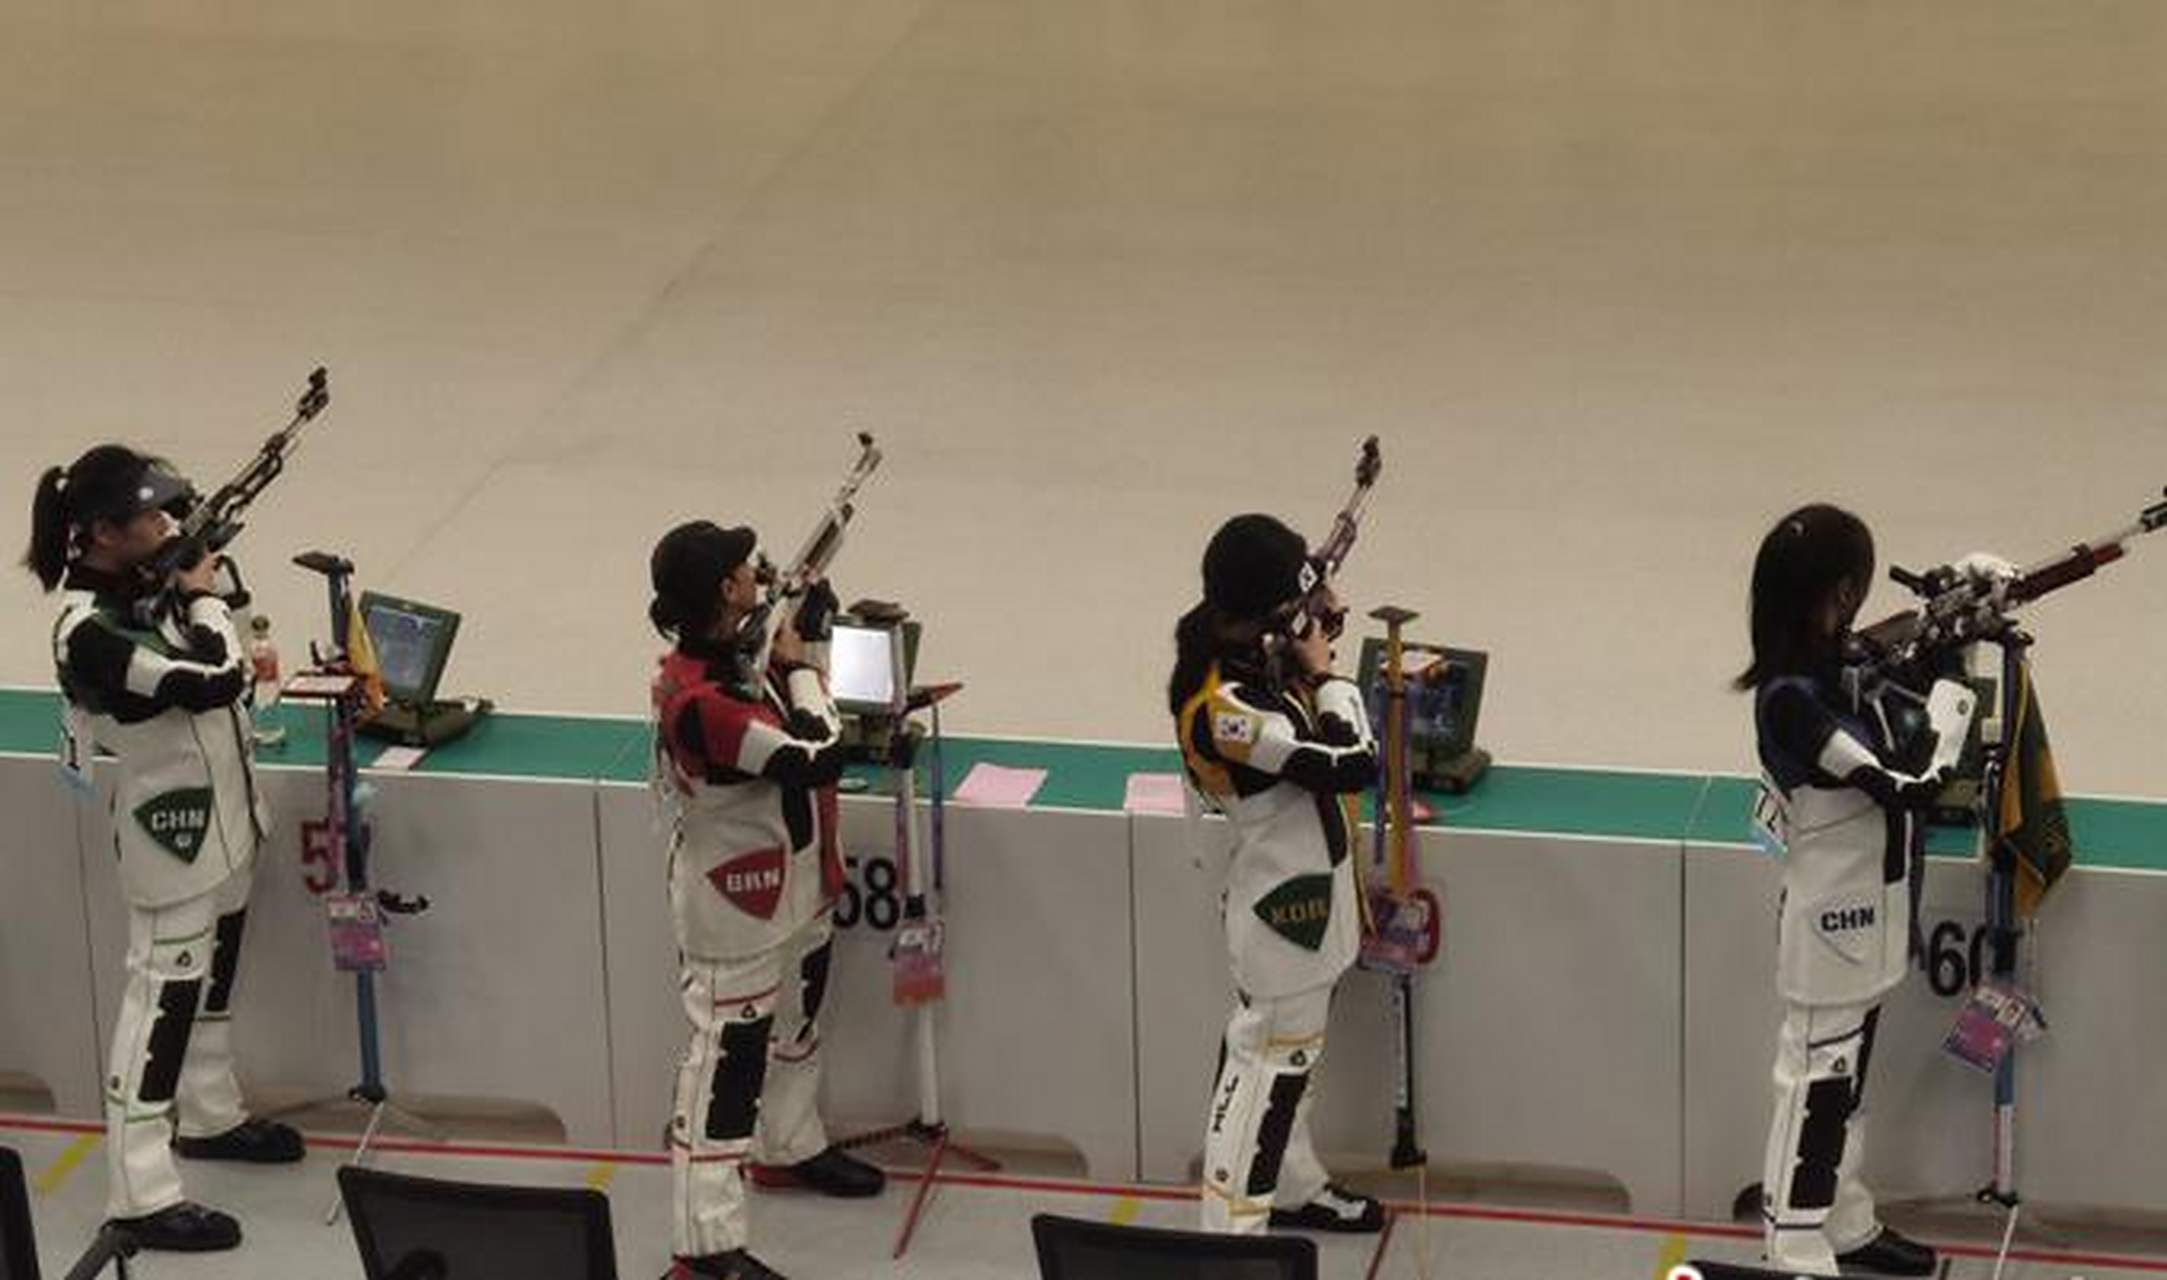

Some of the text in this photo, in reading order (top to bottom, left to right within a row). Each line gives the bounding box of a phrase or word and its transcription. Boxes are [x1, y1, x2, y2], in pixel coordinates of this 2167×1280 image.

[151, 808, 205, 831] CHN
[726, 868, 780, 892] BRN
[831, 857, 900, 931] 58
[1820, 907, 1875, 932] CHN
